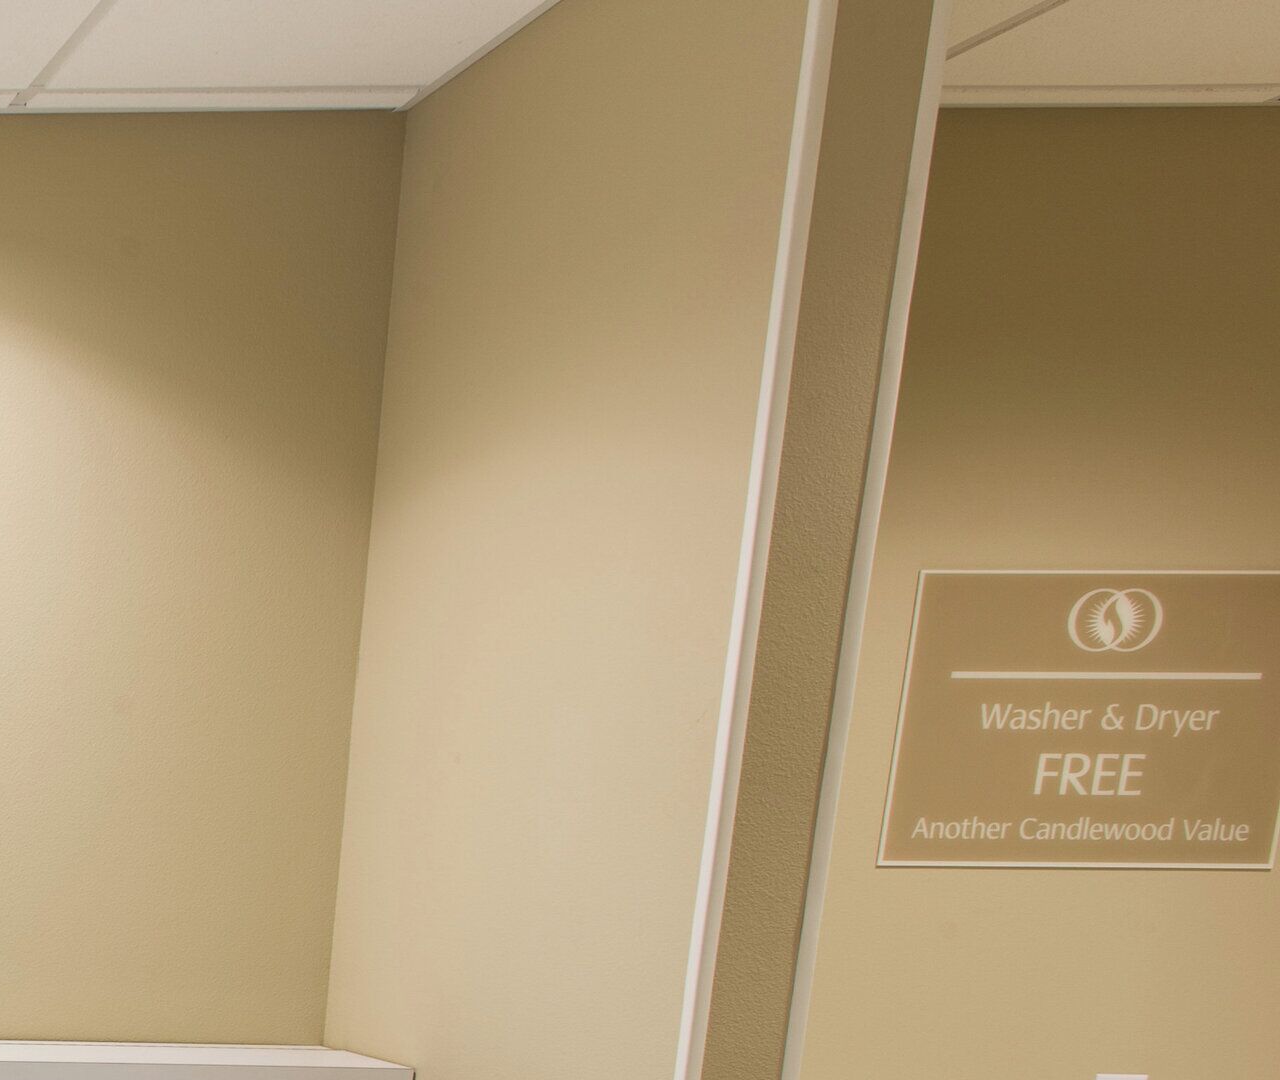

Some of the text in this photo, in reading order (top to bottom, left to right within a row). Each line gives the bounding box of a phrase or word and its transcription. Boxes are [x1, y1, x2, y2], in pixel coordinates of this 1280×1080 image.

[980, 701, 1221, 737] Washer & Dryer
[1032, 752, 1147, 796] FREE
[911, 816, 1250, 842] Another Candlewood Value
